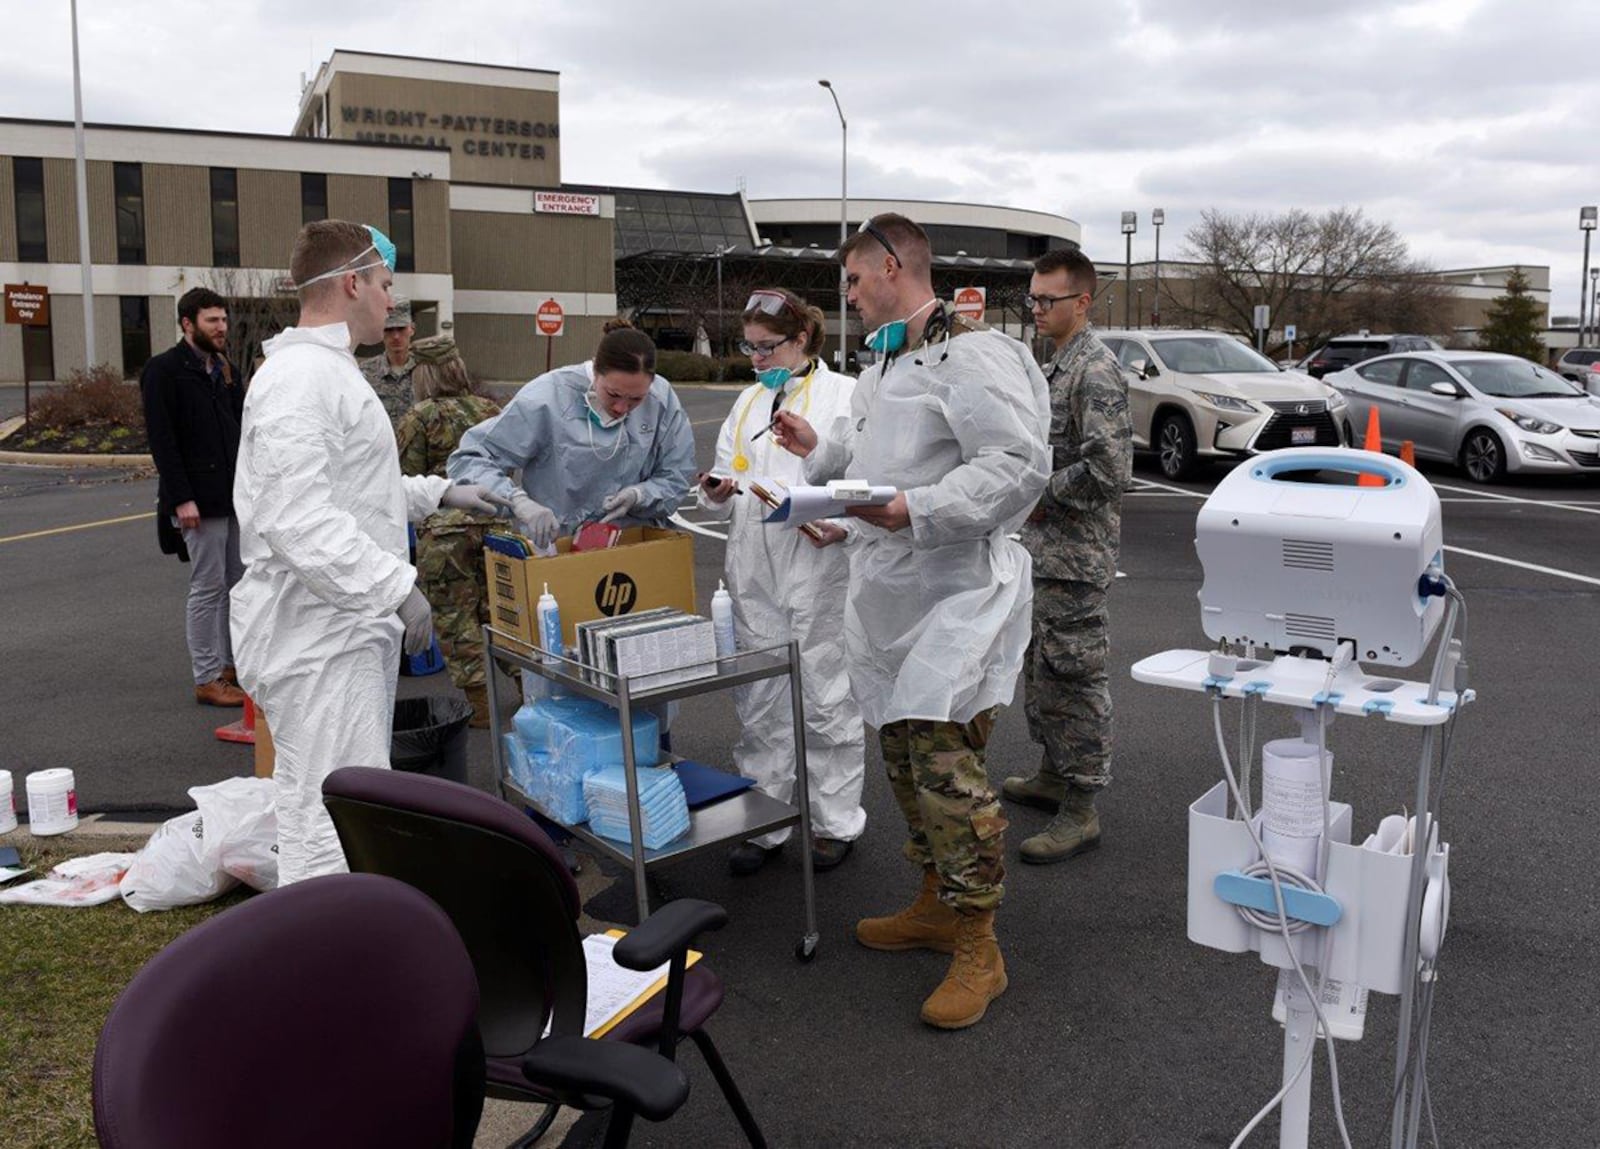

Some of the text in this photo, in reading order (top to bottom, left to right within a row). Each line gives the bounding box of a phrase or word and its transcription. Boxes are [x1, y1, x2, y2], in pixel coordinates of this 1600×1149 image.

[340, 105, 559, 139] WRIGHT-PATTERSON
[463, 139, 546, 161] CENTER
[537, 194, 596, 205] EMERGENCY
[542, 203, 592, 213] ENTRANCE
[9, 291, 43, 301] Ambulance
[12, 300, 40, 309] Entrance
[19, 309, 34, 319] Only
[601, 572, 632, 616] hp
